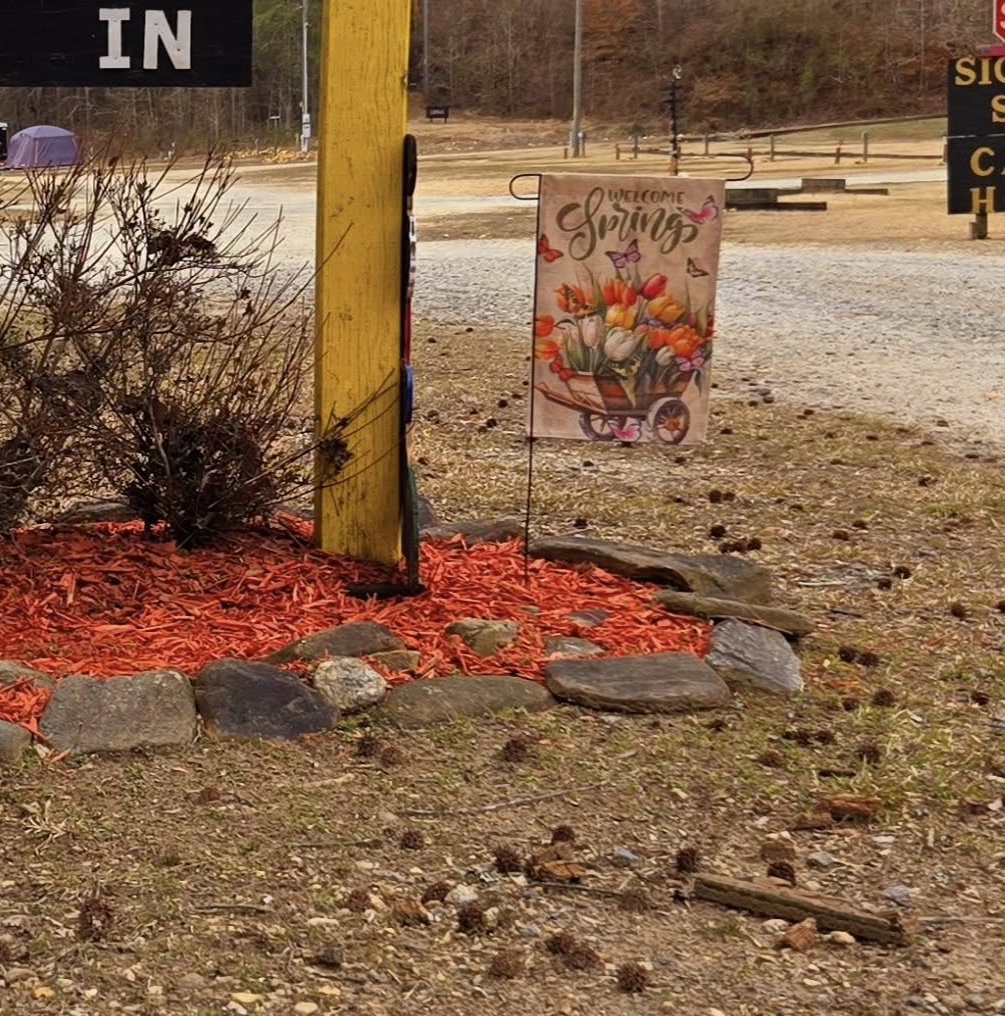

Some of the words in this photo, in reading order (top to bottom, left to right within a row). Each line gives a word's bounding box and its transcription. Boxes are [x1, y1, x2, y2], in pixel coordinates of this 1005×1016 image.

[99, 7, 192, 69] IN
[556, 187, 698, 261] Spring
[608, 188, 685, 205] WELCOME
